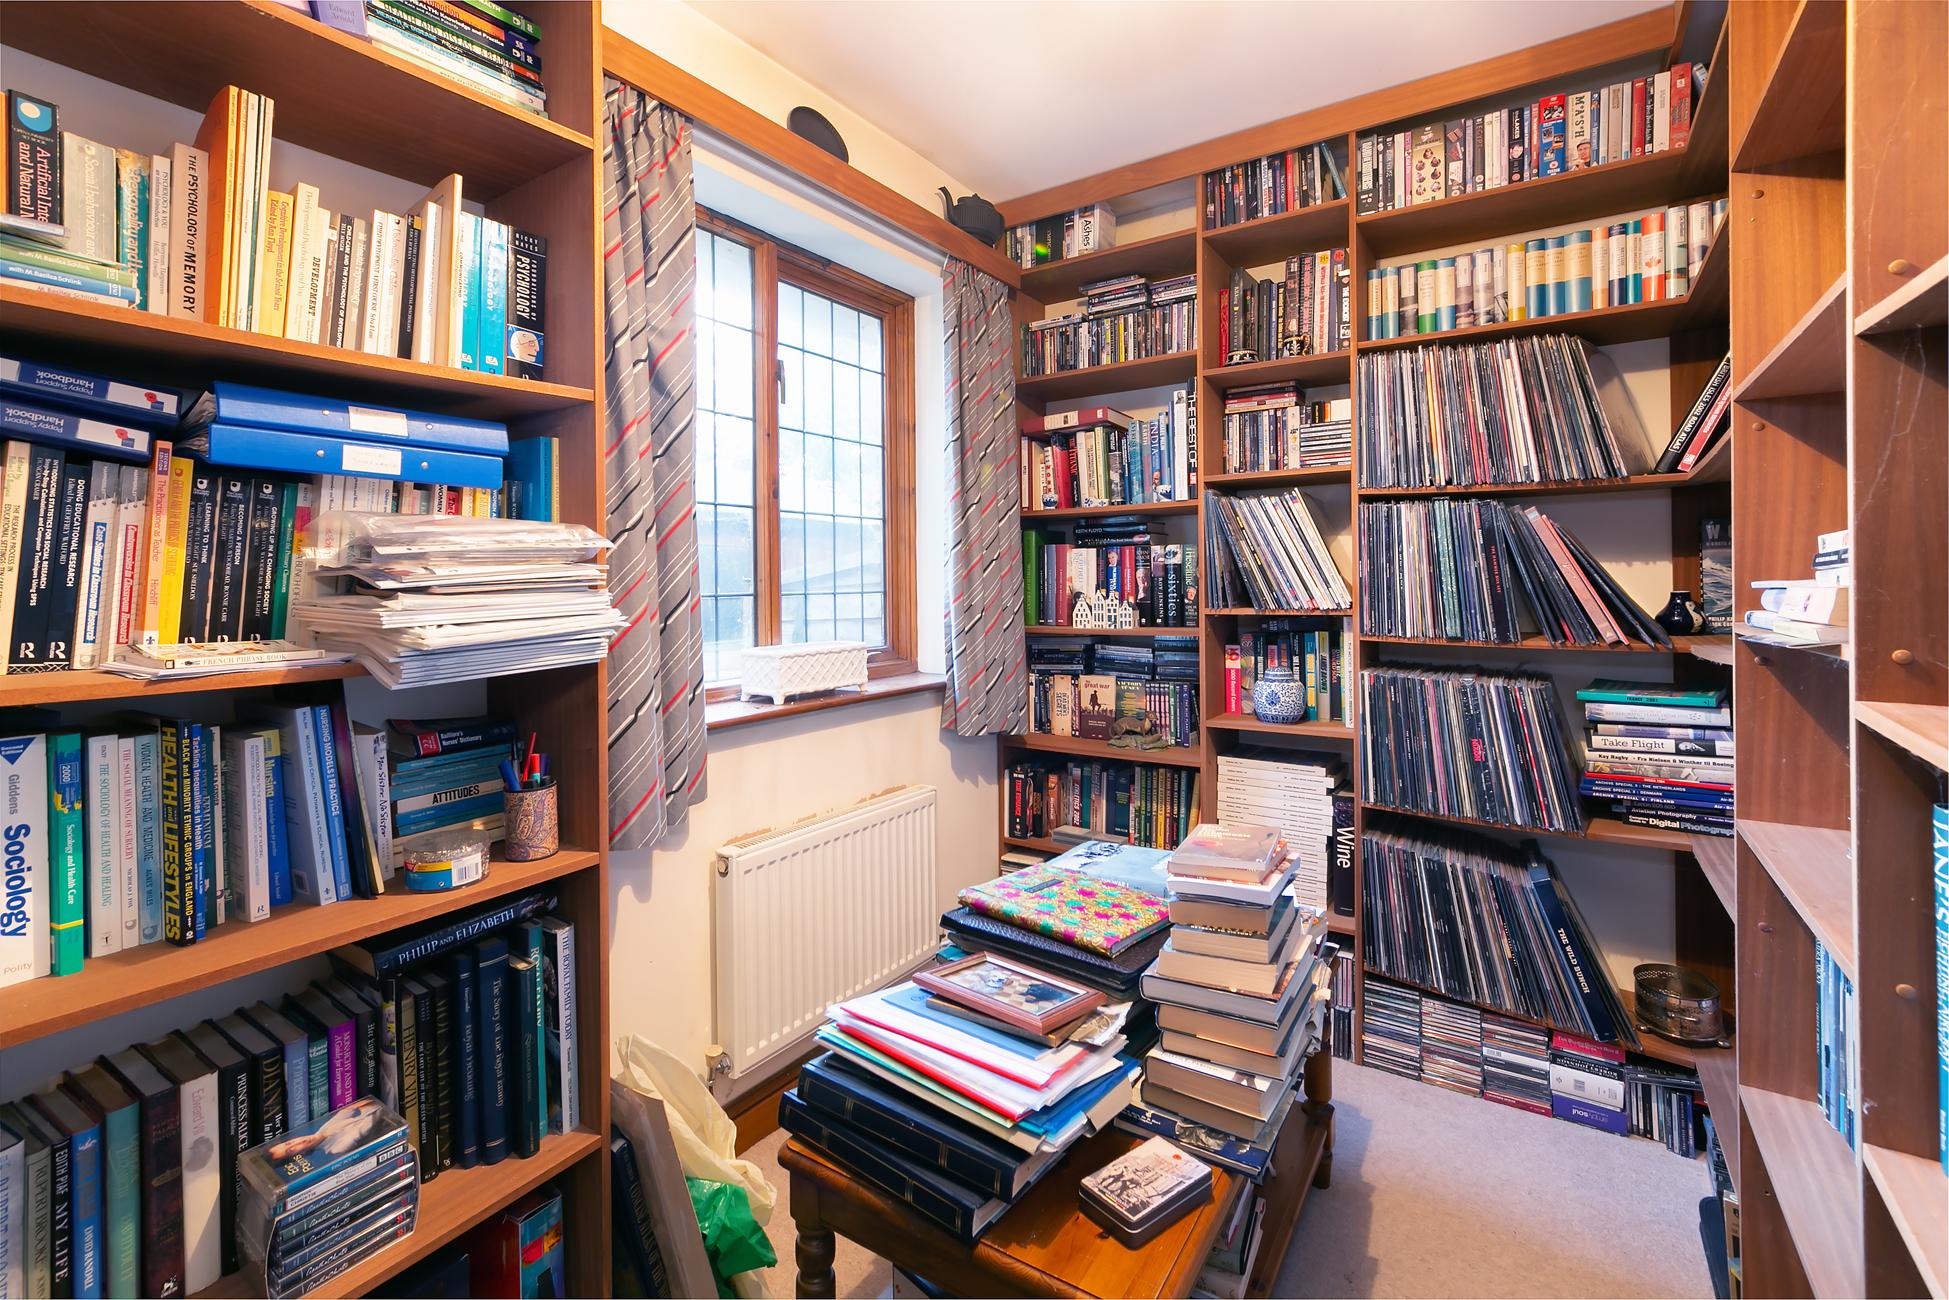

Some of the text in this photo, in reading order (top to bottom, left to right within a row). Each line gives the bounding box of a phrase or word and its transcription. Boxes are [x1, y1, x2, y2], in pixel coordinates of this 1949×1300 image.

[18, 141, 33, 165] and
[36, 146, 51, 200] Artificial
[18, 165, 34, 210] Natural
[183, 154, 198, 312] THE PSYCHOLOGY OF MEMORY
[1082, 219, 1092, 246] Ashes
[308, 255, 320, 316] DEVELOPMENT
[514, 254, 530, 318] PSYCHOLOGY
[529, 259, 538, 320] FOUNDATIONS OF
[36, 370, 95, 390] Handbook
[36, 378, 94, 396] Poppy Support
[4, 416, 64, 433] Poppy Support
[5, 407, 65, 427] Handbook
[1150, 420, 1158, 454] INDIA
[1188, 392, 1196, 467] THE BEST OF
[1067, 446, 1080, 475] TITANIC
[39, 458, 59, 587] INTRODUCING STATISTICS FOR SOCIAL RESEARCH
[65, 478, 85, 586] DOING EDUCATIONAL RESEARCH
[200, 501, 212, 563] LEARNING TO THINK
[236, 503, 244, 534] BECOMING
[268, 535, 275, 543] UP
[269, 506, 277, 534] GROWING
[233, 541, 242, 564] PERSON
[1184, 551, 1195, 586] Heseltine
[264, 558, 273, 589] CHANGING
[262, 590, 270, 614] SOCIETY
[1167, 573, 1179, 616] sixties
[1054, 691, 1062, 717] SECRETS
[319, 708, 339, 816] NURSING MODELS PRACTICE
[1601, 738, 1665, 751] Take Flight
[1648, 756, 1671, 764] Nielsen
[1712, 761, 1735, 769] Boeing
[61, 764, 71, 783] 2000
[161, 726, 177, 806] HEALTH
[264, 759, 277, 797] Nursing
[1594, 762, 1611, 774] 75
[8, 773, 20, 814] Giddens
[122, 749, 132, 860] THE SOCIAL MEANING OF SURGERY
[432, 784, 480, 805] ATTITUDES
[99, 763, 111, 906] THE SOCIOLOGY OF HEALTH AND HEALING
[181, 738, 193, 914] BLACK and MINORITY ETHNIC GROUPS in ENGLAND
[1649, 817, 1680, 829] Digital
[1657, 809, 1697, 820] Photography
[64, 824, 76, 904] Sociology and Health Care
[1336, 827, 1355, 869] Wine
[0, 823, 33, 938] Sociology
[163, 821, 180, 939] LIFESTYLES
[1932, 819, 1949, 921] JANE'S
[398, 909, 515, 965] PHILIP AND ELIZABETH
[1190, 924, 1216, 932] RETREAT
[1227, 930, 1254, 938] VICTORY
[3, 961, 33, 977] Polity
[1557, 928, 1590, 994] THE WILD BUNCH
[561, 935, 571, 1040] THE ROYAL FAMILY TODAY
[262, 1055, 280, 1120] DIANA
[402, 1024, 417, 1111] HENRY VIII
[1556, 1057, 1618, 1077] ROBERT JOHNSON
[237, 1072, 247, 1151] PRINCESS ALICE
[1572, 1107, 1589, 1118] soul
[55, 1148, 68, 1194] EDITH PIAF
[55, 1201, 68, 1282] MY LIFE
